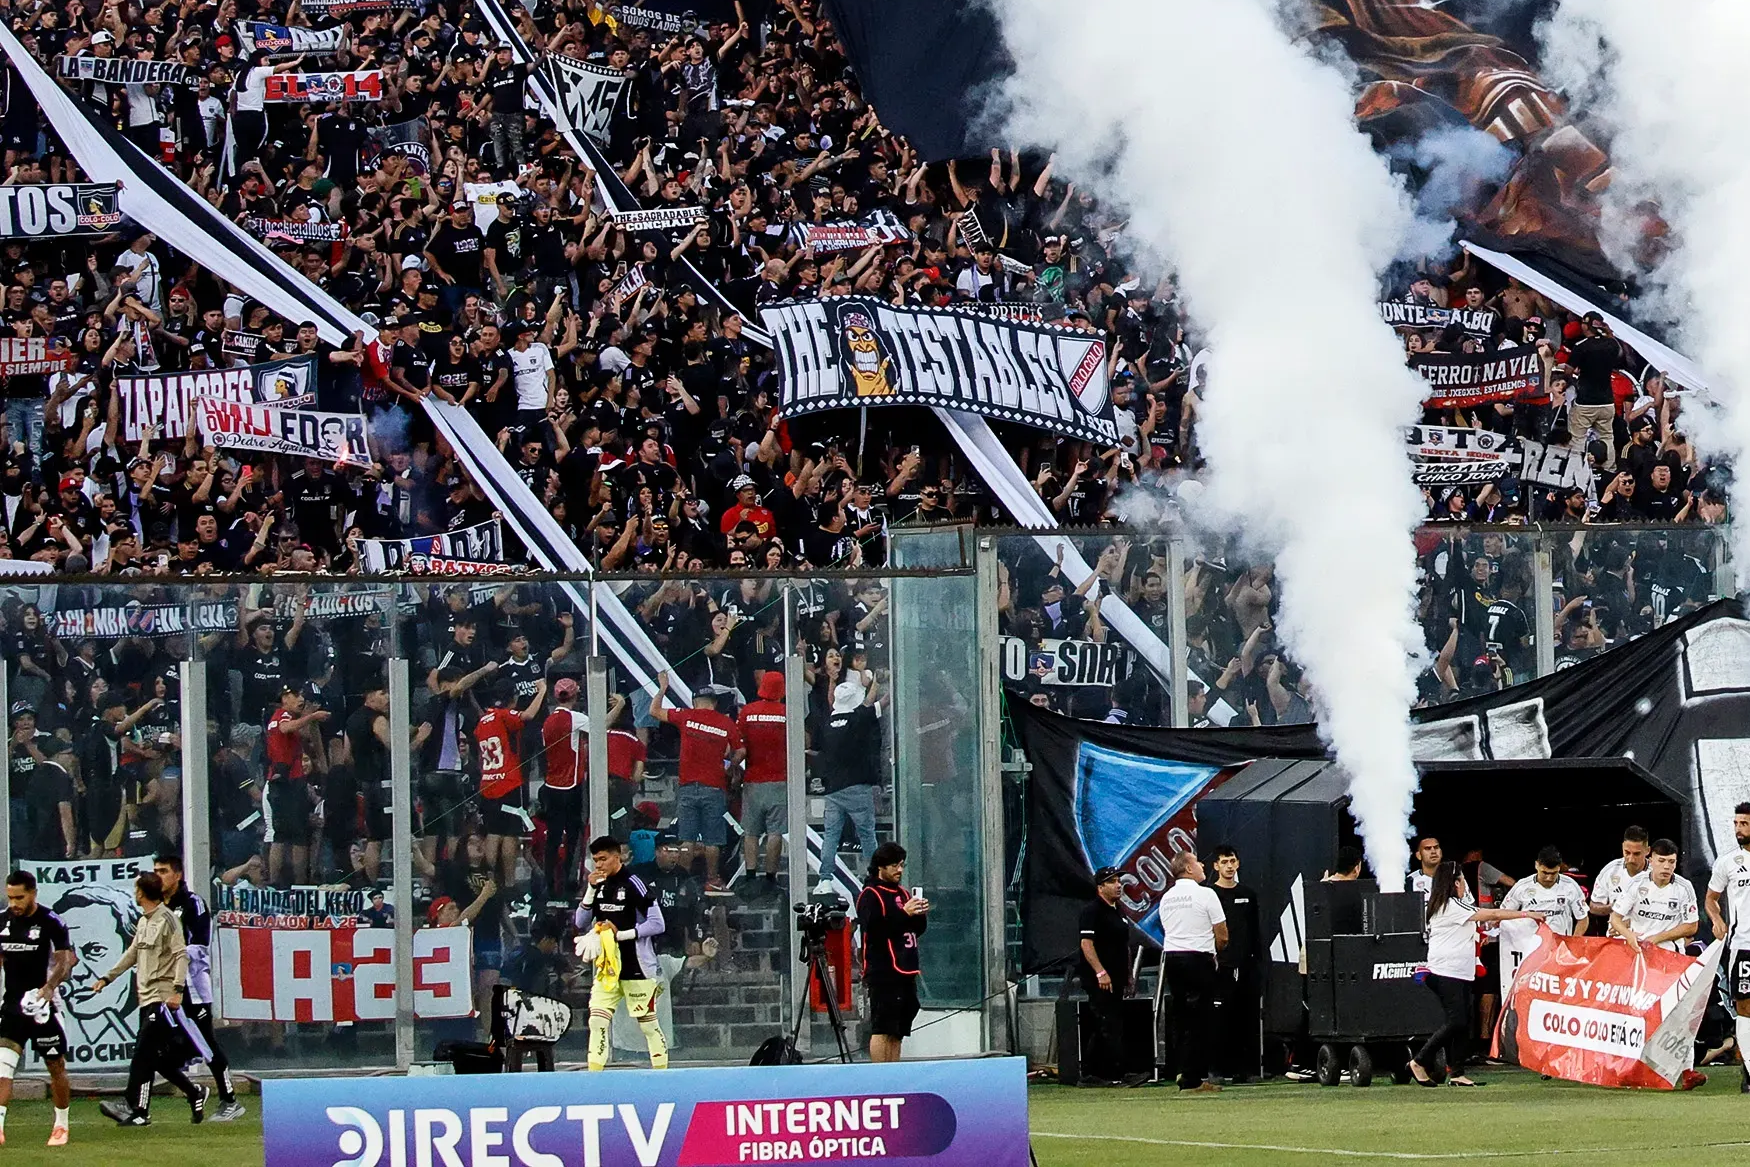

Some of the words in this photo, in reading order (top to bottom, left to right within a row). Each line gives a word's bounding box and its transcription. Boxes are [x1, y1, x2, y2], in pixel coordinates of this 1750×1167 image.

[622, 5, 662, 20] SOMOS
[665, 12, 680, 23] DE
[622, 14, 649, 27] TODOS
[651, 19, 682, 33] LADOS
[59, 57, 80, 78] LA
[93, 60, 186, 84] BANDERA
[265, 75, 308, 100] EL
[343, 73, 382, 98] 14
[5, 359, 67, 375] SIEMPRE
[760, 303, 839, 406] THE
[877, 306, 1075, 423] TESTABLES
[1481, 353, 1540, 382] NAVIA
[1484, 379, 1527, 395] ESTAREMOS
[117, 370, 253, 441] ZAPADORES
[227, 433, 266, 448] Pedro
[65, 607, 129, 636] CHMBA
[515, 680, 537, 691] Pilse
[36, 864, 101, 885] KAST
[111, 861, 140, 881] ES
[218, 885, 235, 911] LA
[239, 887, 290, 914] BANDA
[293, 890, 320, 916] DEL
[324, 890, 364, 916] KEKO
[217, 910, 250, 926] SAN
[253, 914, 308, 930] RAMON
[313, 915, 332, 930] LA
[218, 929, 334, 1021] LA
[1738, 960, 1750, 977] 15
[1529, 972, 1561, 995] ESTE
[1580, 978, 1592, 999] Y
[1595, 981, 1610, 1002] 29
[1543, 1012, 1581, 1036] COLO
[1584, 1018, 1608, 1042] COLO
[724, 1097, 905, 1137] INTERNET
[324, 1100, 676, 1167] DIRECTV
[738, 1140, 803, 1162] FIBRA
[809, 1132, 887, 1159] ÓPTICA
